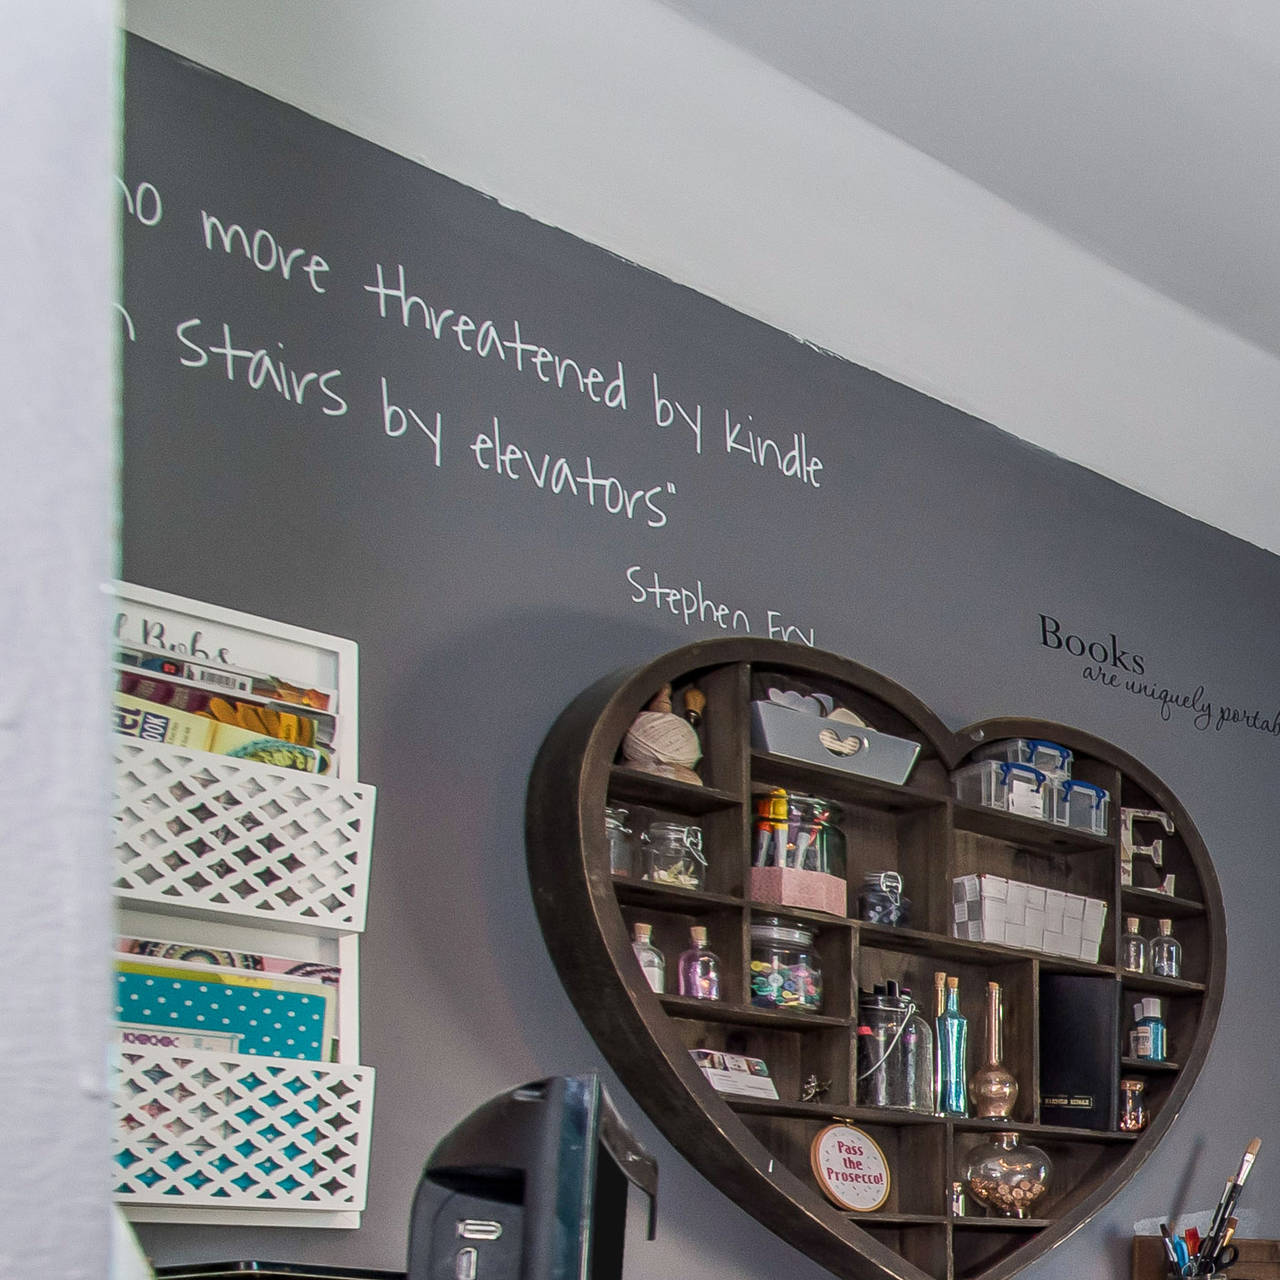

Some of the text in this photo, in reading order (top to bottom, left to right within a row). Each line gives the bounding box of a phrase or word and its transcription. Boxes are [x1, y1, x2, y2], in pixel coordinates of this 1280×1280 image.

[201, 210, 330, 293] more
[365, 264, 627, 409] threatened
[654, 373, 703, 452] by
[382, 377, 443, 467] by
[626, 566, 750, 633] Stephen
[1038, 613, 1145, 675] Books
[1083, 665, 1122, 688] are
[1126, 685, 1212, 731] uniquely
[826, 1167, 885, 1185] Prosecco!
[837, 1140, 863, 1156] Pass
[842, 1156, 863, 1171] the
